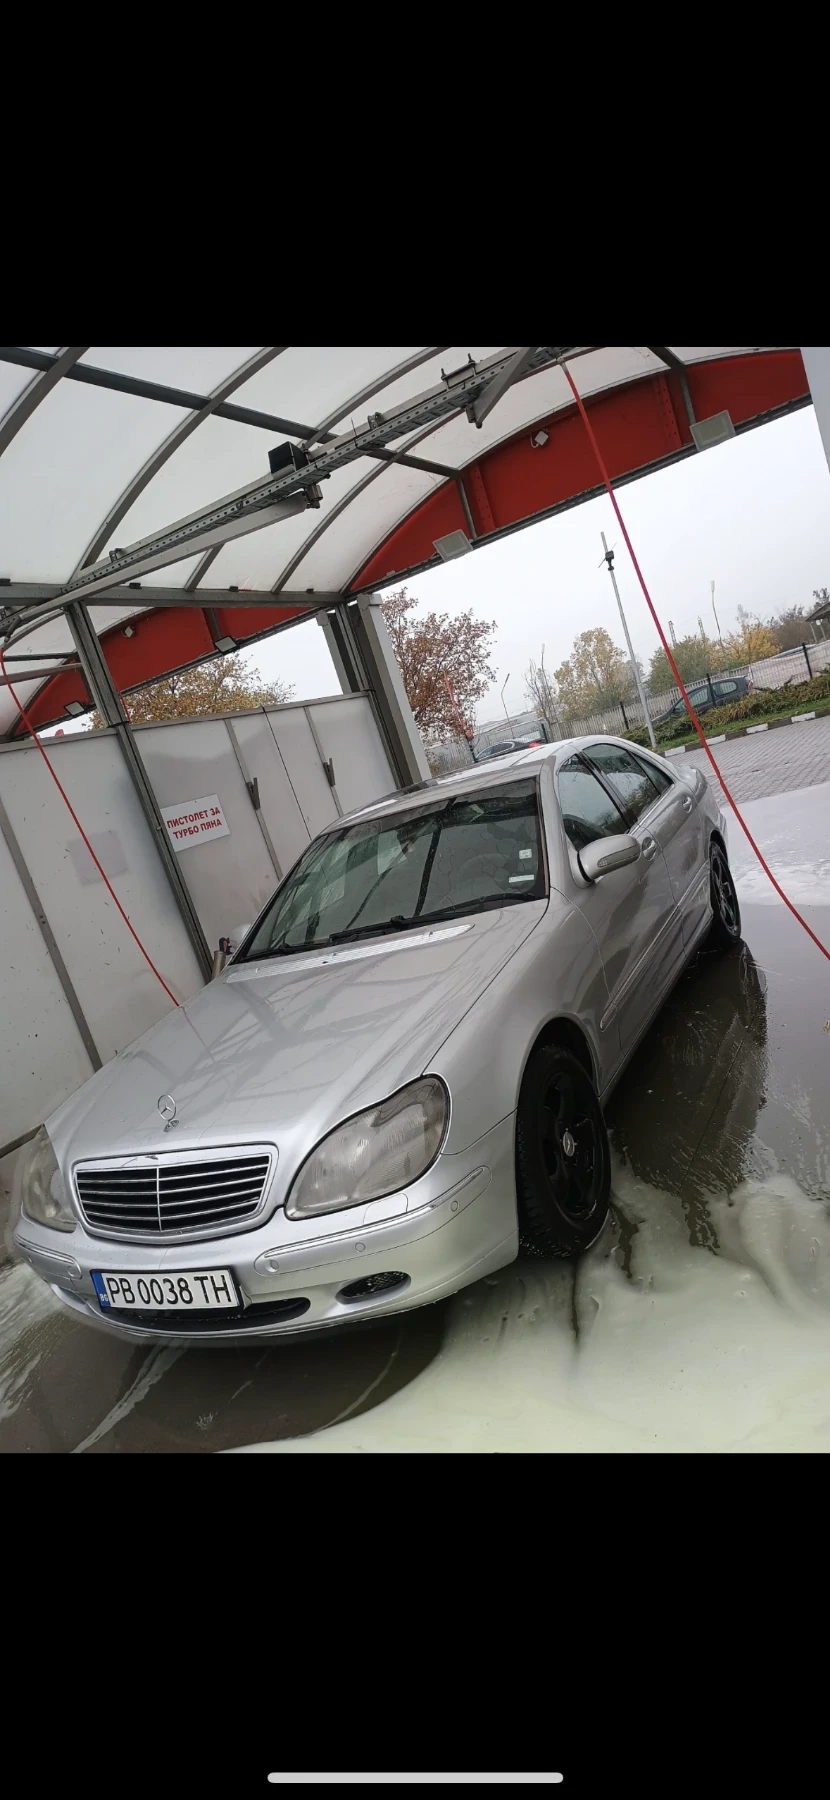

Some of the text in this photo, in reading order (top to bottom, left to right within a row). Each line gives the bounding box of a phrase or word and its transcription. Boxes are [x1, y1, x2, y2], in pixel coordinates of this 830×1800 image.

[166, 807, 221, 828] ПИСТОЛЕТ ЗА
[173, 819, 222, 840] ТУРБО ПЯНА
[106, 1275, 232, 1305] PB 0038 TH
